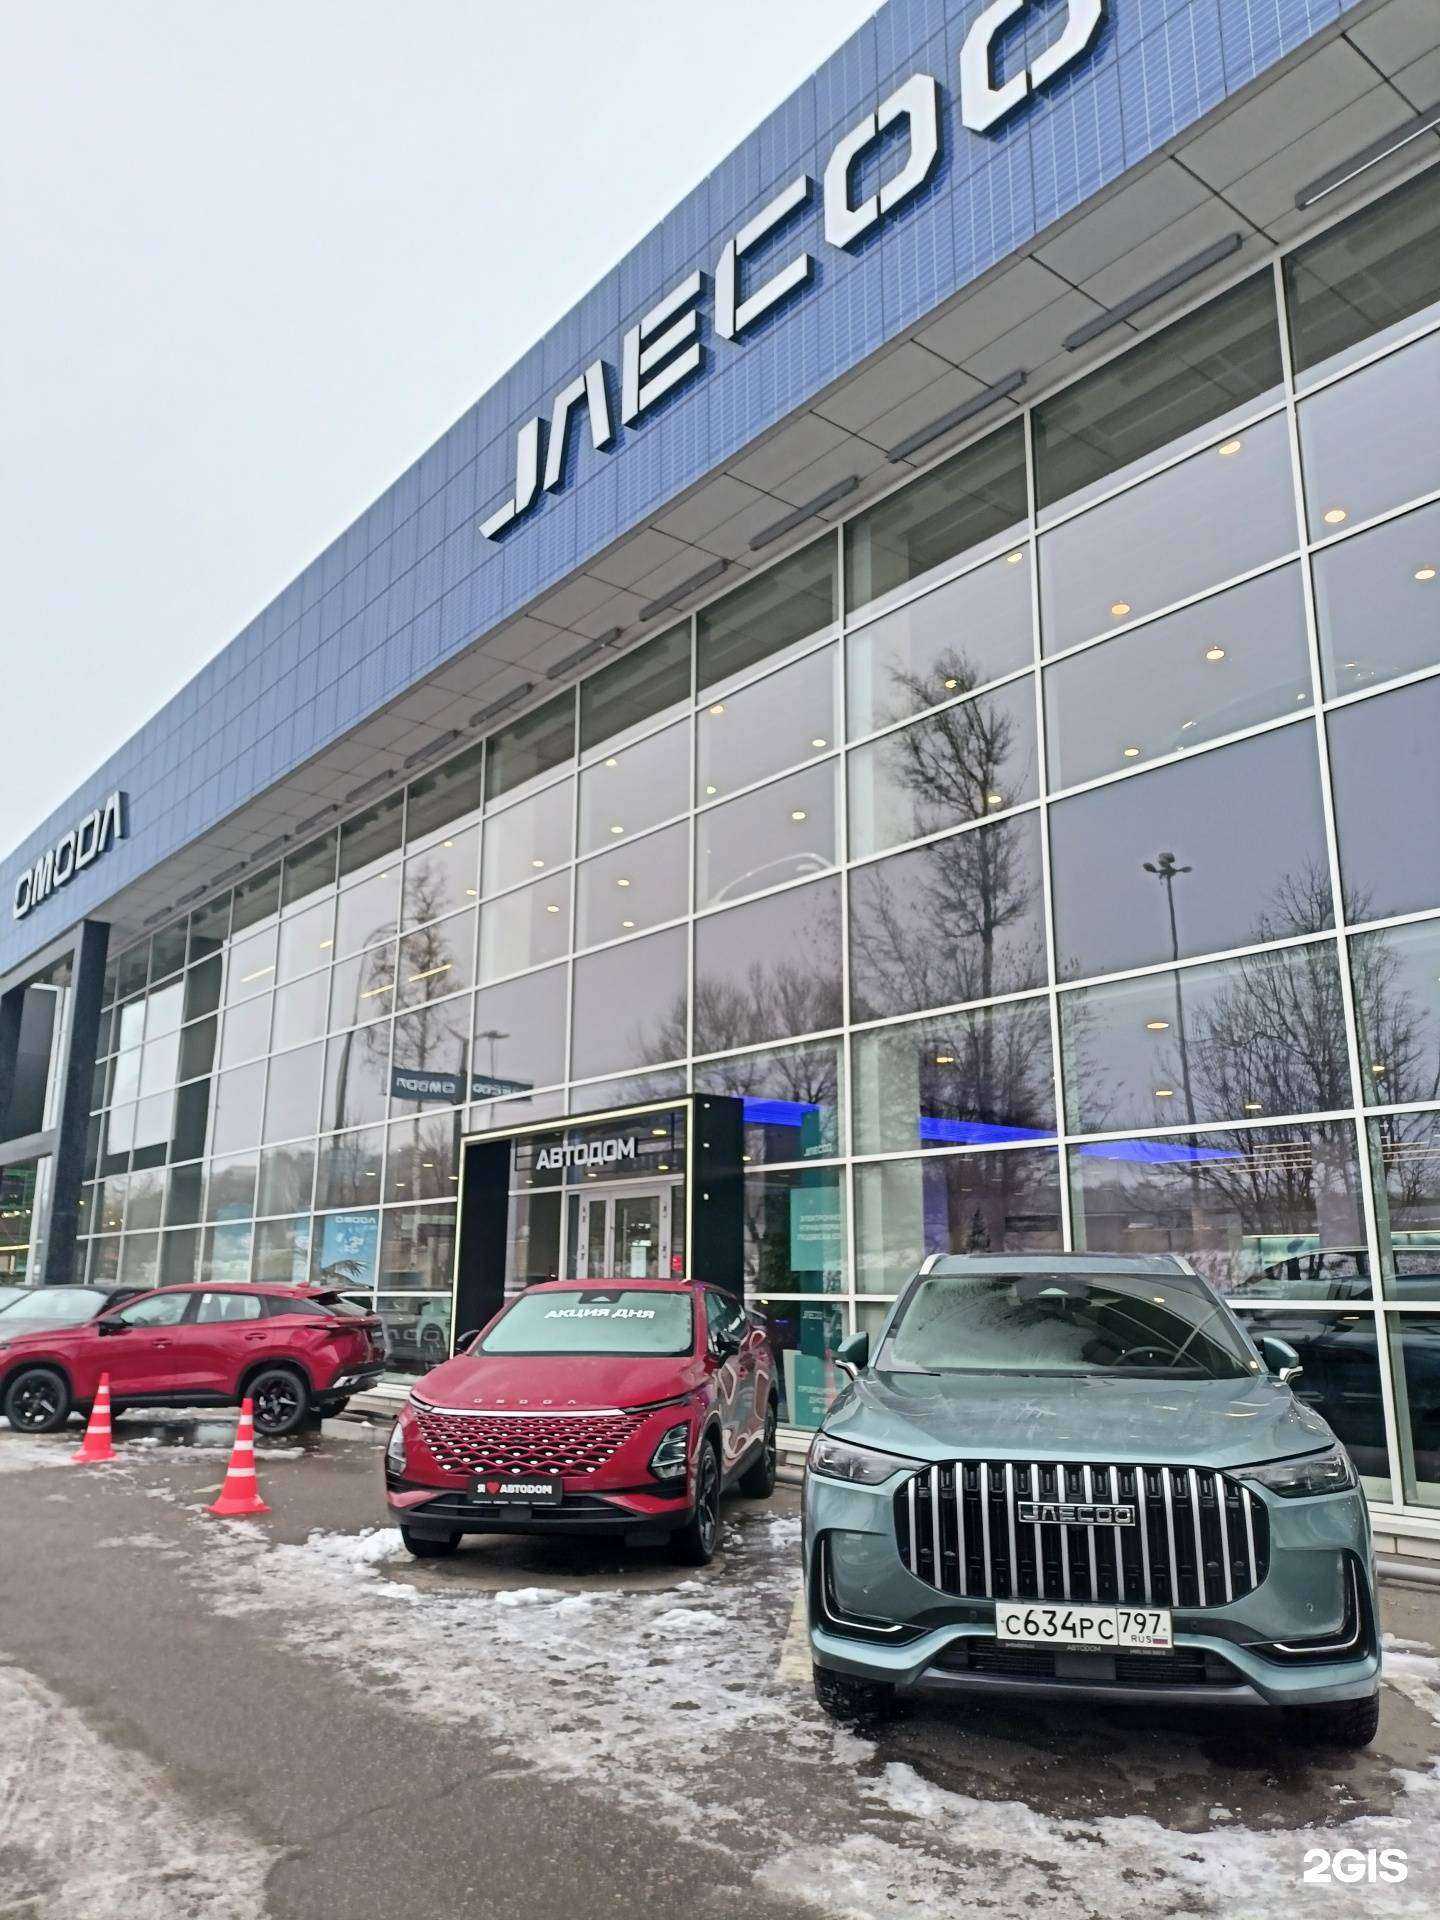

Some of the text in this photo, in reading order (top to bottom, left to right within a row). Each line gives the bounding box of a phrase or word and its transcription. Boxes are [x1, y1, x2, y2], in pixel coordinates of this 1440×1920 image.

[14, 790, 121, 920] OMODA
[536, 1137, 635, 1170] АВТОДОМ
[544, 1309, 655, 1319] АКЦИЯ ДНЯ
[1021, 1505, 1132, 1523] JAECOO
[1119, 1611, 1161, 1635] 797
[1131, 1634, 1152, 1644] RUS
